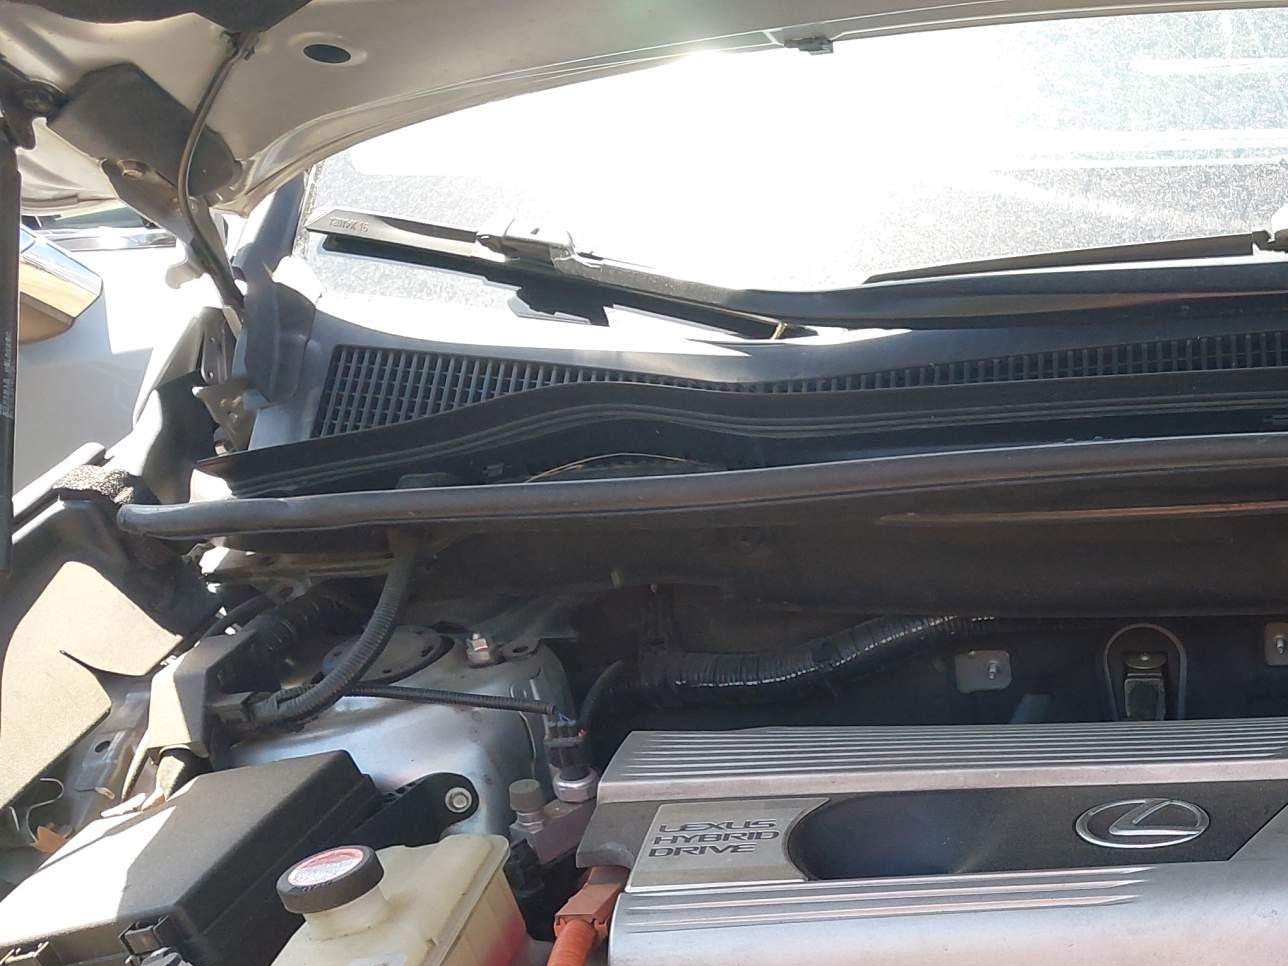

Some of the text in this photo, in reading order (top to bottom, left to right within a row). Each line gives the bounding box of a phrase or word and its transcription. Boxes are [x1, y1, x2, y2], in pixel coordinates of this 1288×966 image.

[659, 819, 777, 833] LEXUS
[653, 829, 780, 845] HYBRID
[648, 842, 757, 857] DRIVE
